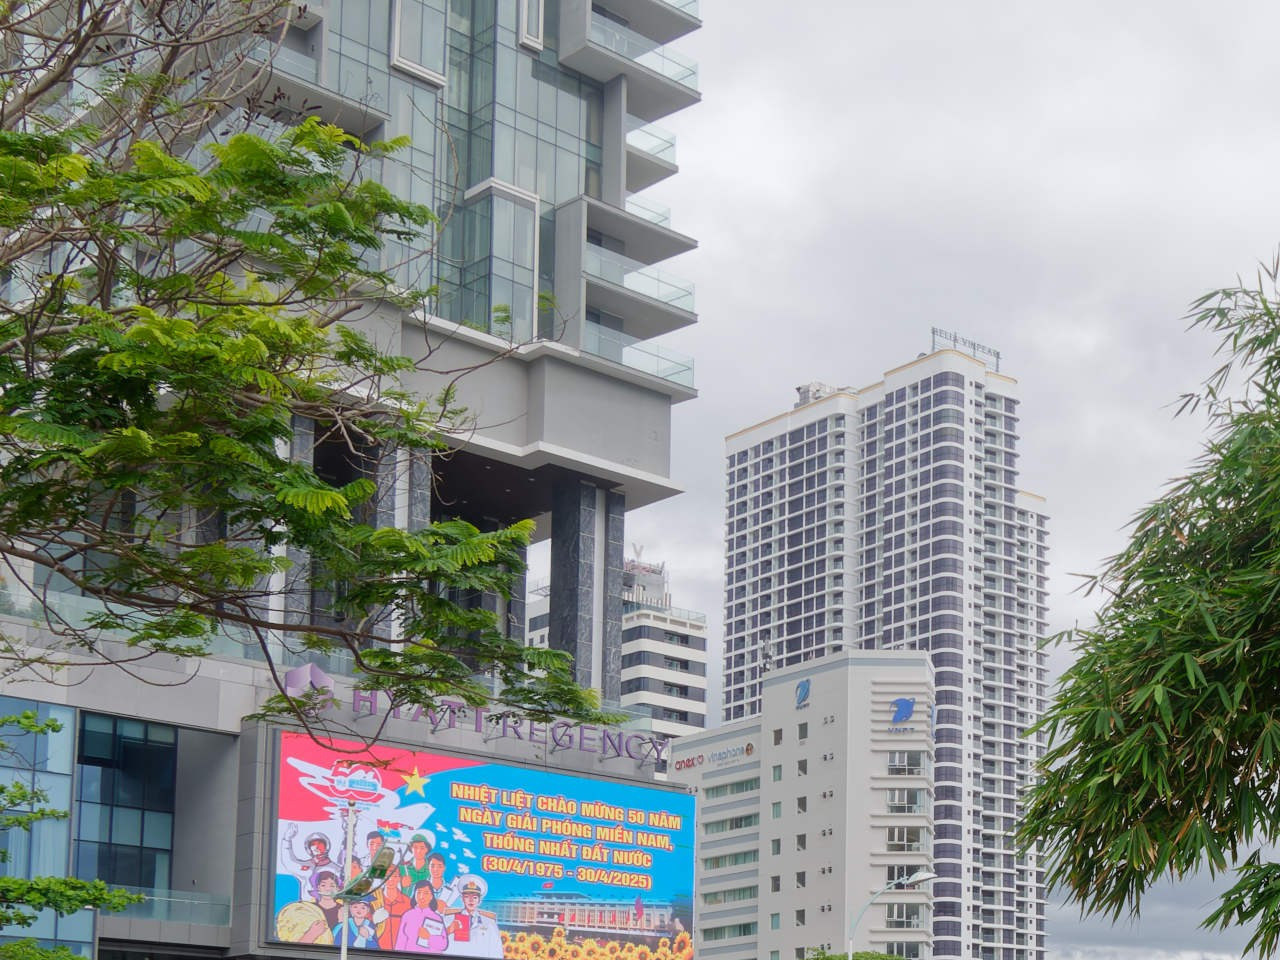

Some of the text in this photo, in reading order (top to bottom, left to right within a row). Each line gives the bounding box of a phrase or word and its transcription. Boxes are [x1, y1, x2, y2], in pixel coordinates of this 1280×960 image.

[501, 710, 669, 764] REGENCY
[451, 784, 681, 830] NHIỆT LIỆT CHÀO MỪNG 50 NĂM
[459, 807, 503, 826] NGÀY
[506, 813, 537, 831] GIẢI
[541, 819, 592, 838] PHÓNG
[637, 832, 673, 851] NAM,
[484, 831, 652, 867] THỐNG NHẤT ĐẤT NƯỚC
[482, 856, 564, 878] (30/4/1975
[577, 868, 652, 889] 30/4/2025)
